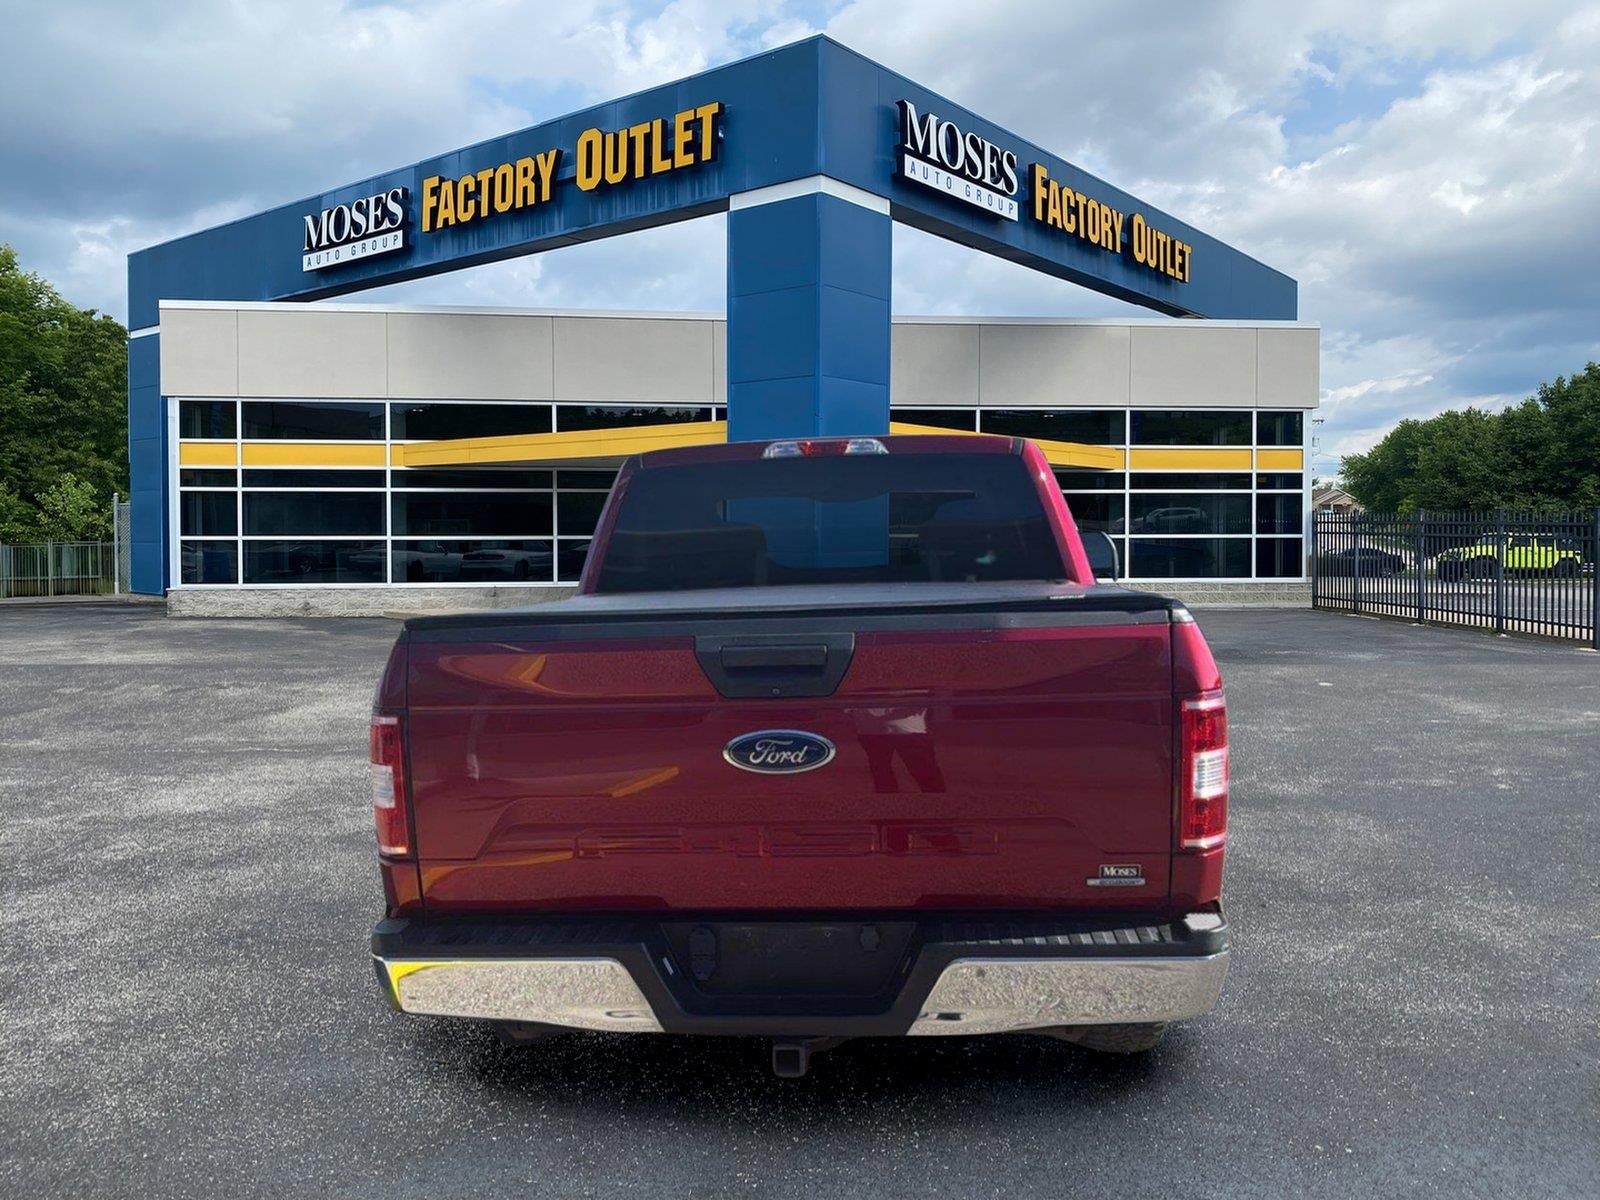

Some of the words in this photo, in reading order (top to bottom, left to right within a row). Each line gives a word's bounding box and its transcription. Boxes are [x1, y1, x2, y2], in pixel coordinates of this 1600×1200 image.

[422, 148, 559, 233] FACTORY
[575, 101, 721, 192] OUTLET
[904, 99, 1018, 196] MOSES
[909, 160, 953, 190] AUTO
[965, 184, 1014, 215] GROUP
[303, 188, 404, 251] MOSES
[306, 248, 341, 268] AUTO
[351, 234, 399, 257] GROUP
[1034, 162, 1124, 254] FACTORY
[1131, 212, 1192, 283] OUTLET
[749, 739, 809, 764] Ford
